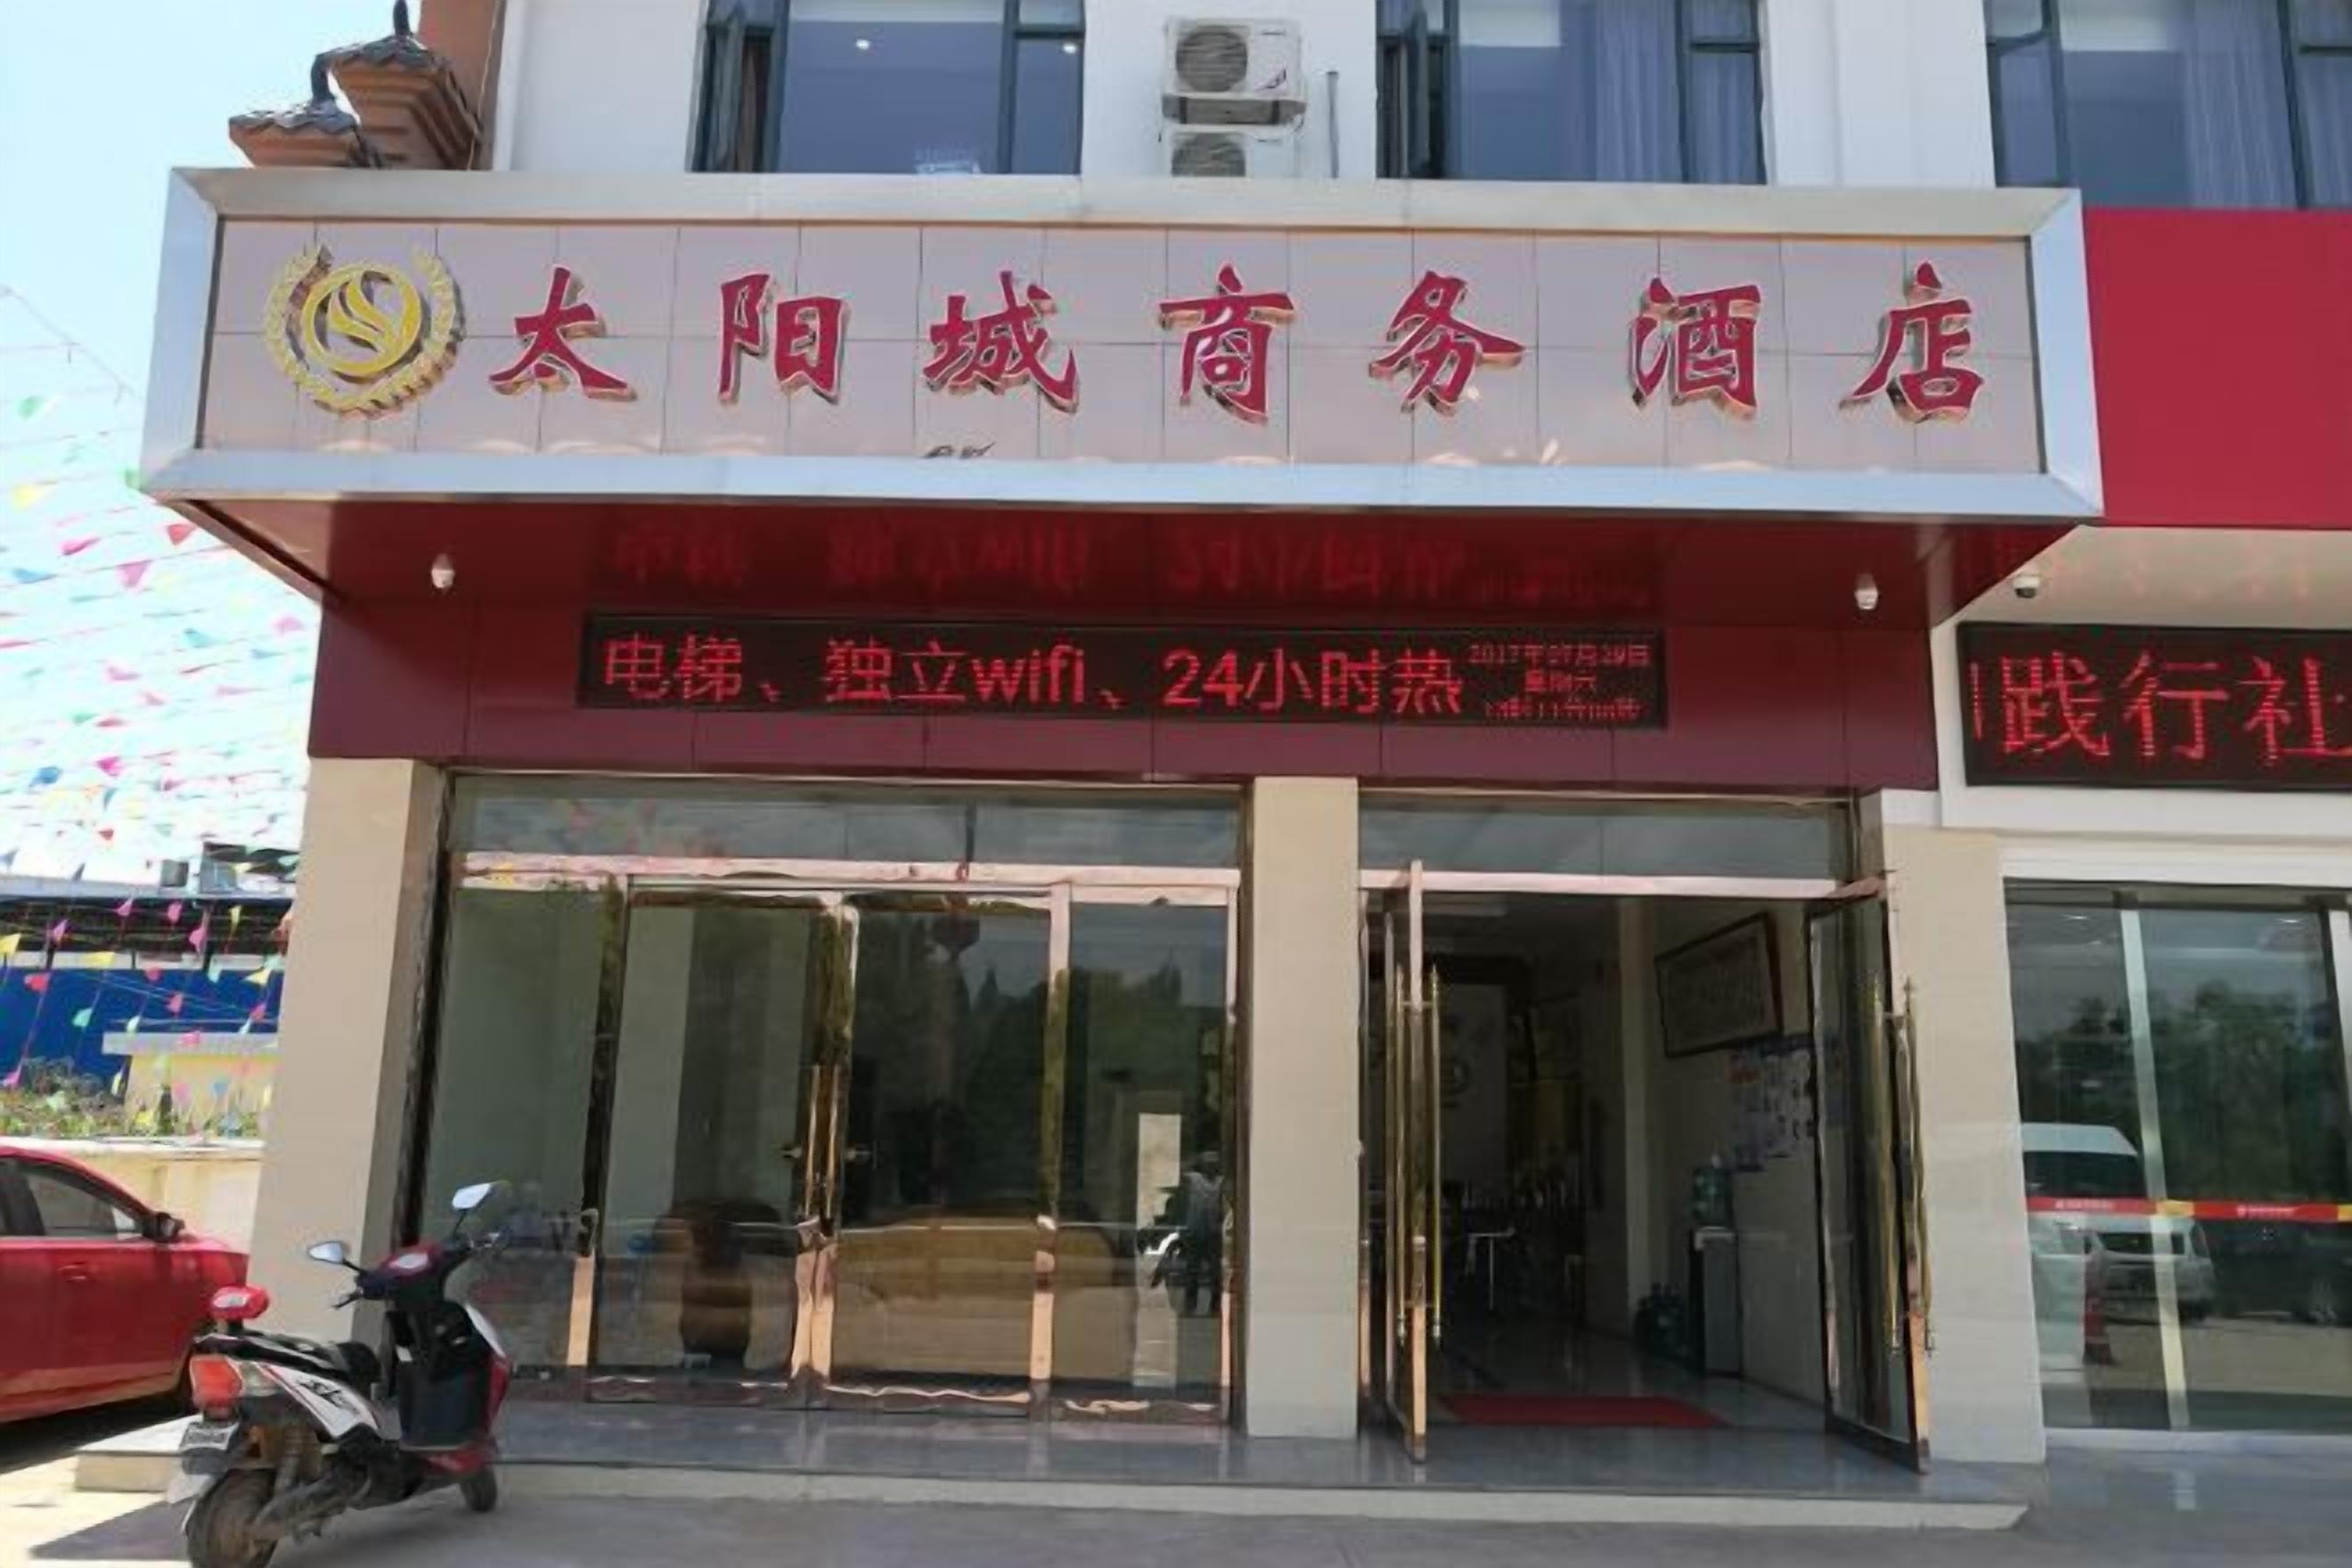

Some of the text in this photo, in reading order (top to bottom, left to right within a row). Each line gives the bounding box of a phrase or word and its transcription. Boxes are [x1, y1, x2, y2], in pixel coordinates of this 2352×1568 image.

[492, 263, 1985, 422] 太阳城商务酒店
[1970, 651, 2352, 764] 践行社
